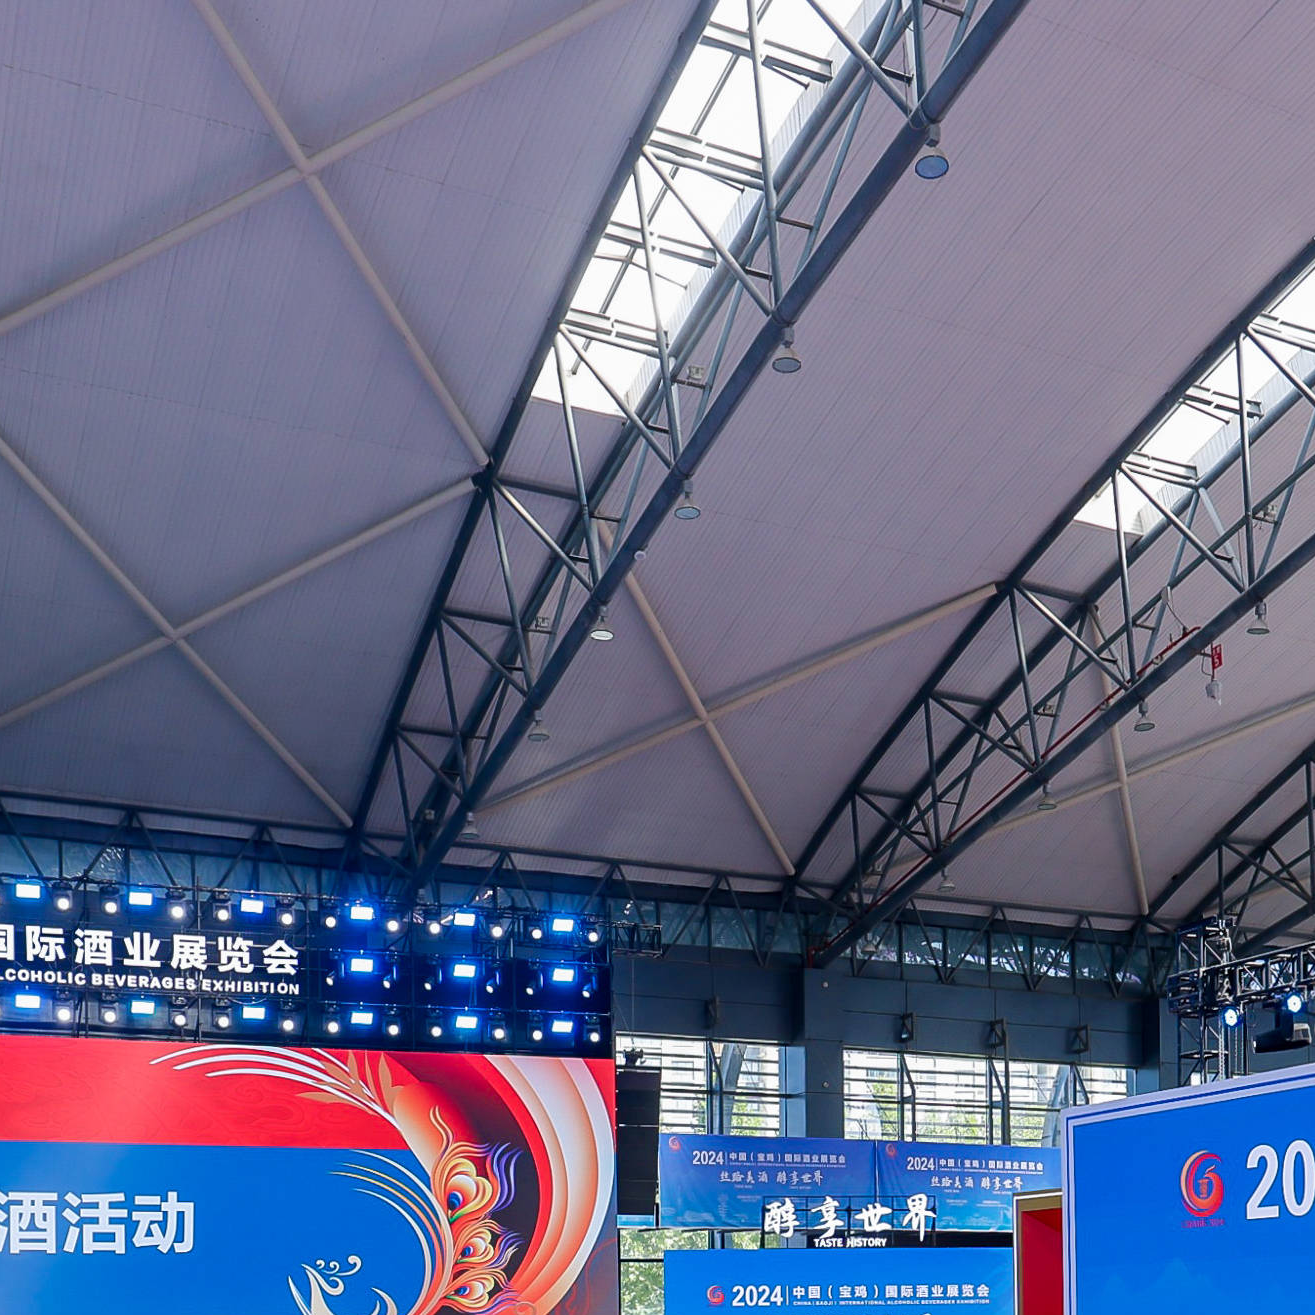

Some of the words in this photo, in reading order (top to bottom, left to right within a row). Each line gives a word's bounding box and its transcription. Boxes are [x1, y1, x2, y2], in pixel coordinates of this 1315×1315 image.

[91, 973, 198, 991] BEVERAGES
[201, 978, 300, 995] EXHIBITION
[692, 1150, 724, 1165] 2024
[906, 1156, 935, 1171] 2024
[764, 1193, 937, 1242] 醇享世界
[813, 1237, 843, 1248] TASTE
[846, 1237, 887, 1248] HISTORY
[731, 1285, 784, 1307] 2024
